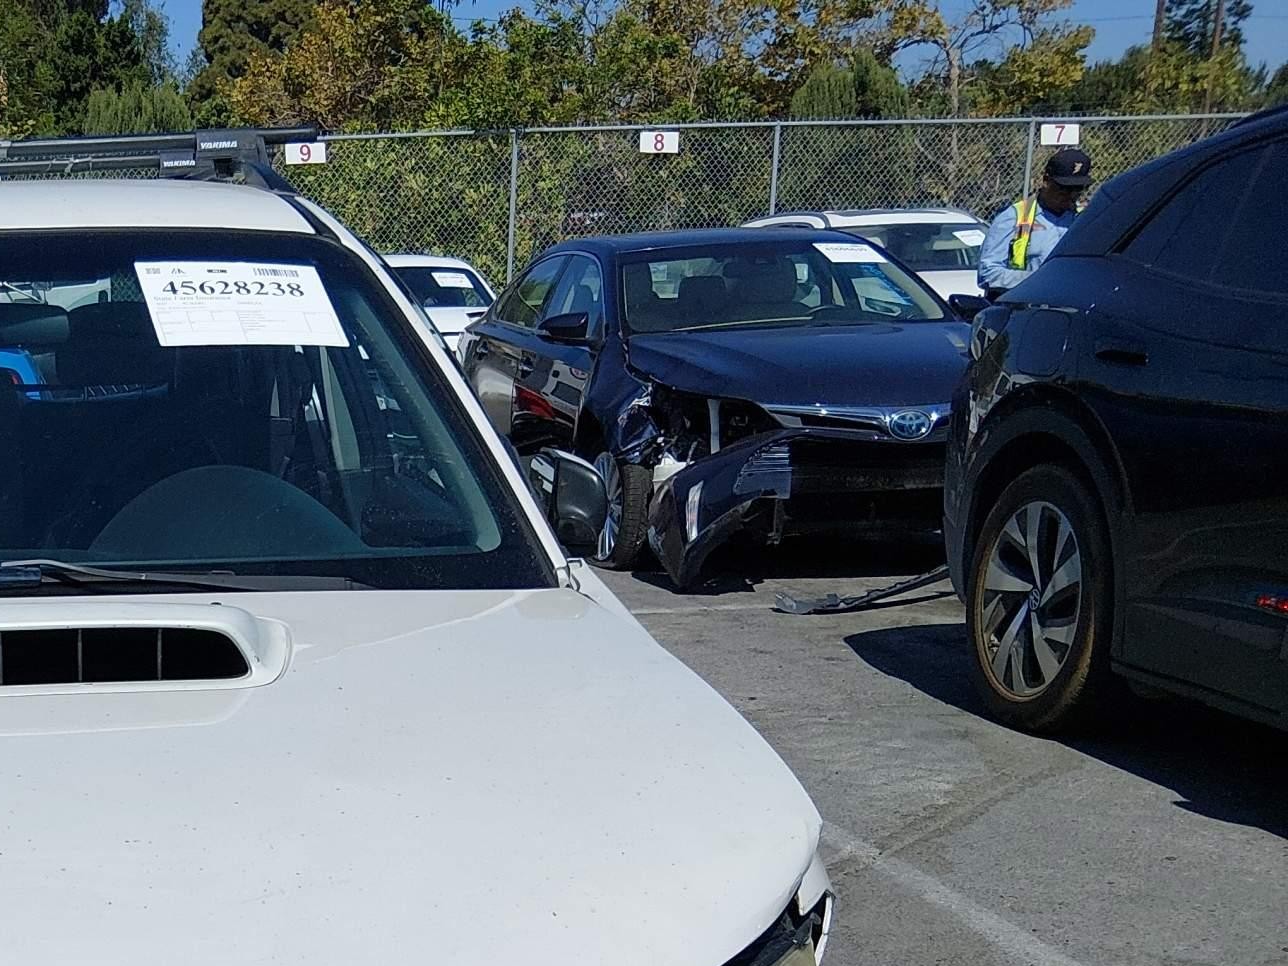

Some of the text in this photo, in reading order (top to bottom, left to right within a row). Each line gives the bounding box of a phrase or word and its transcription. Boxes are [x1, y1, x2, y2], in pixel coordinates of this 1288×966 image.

[1055, 124, 1065, 143] 7
[200, 141, 237, 149] YAKIMA
[654, 134, 664, 151] 8
[299, 144, 311, 162] 9
[162, 280, 305, 297] 45628238
